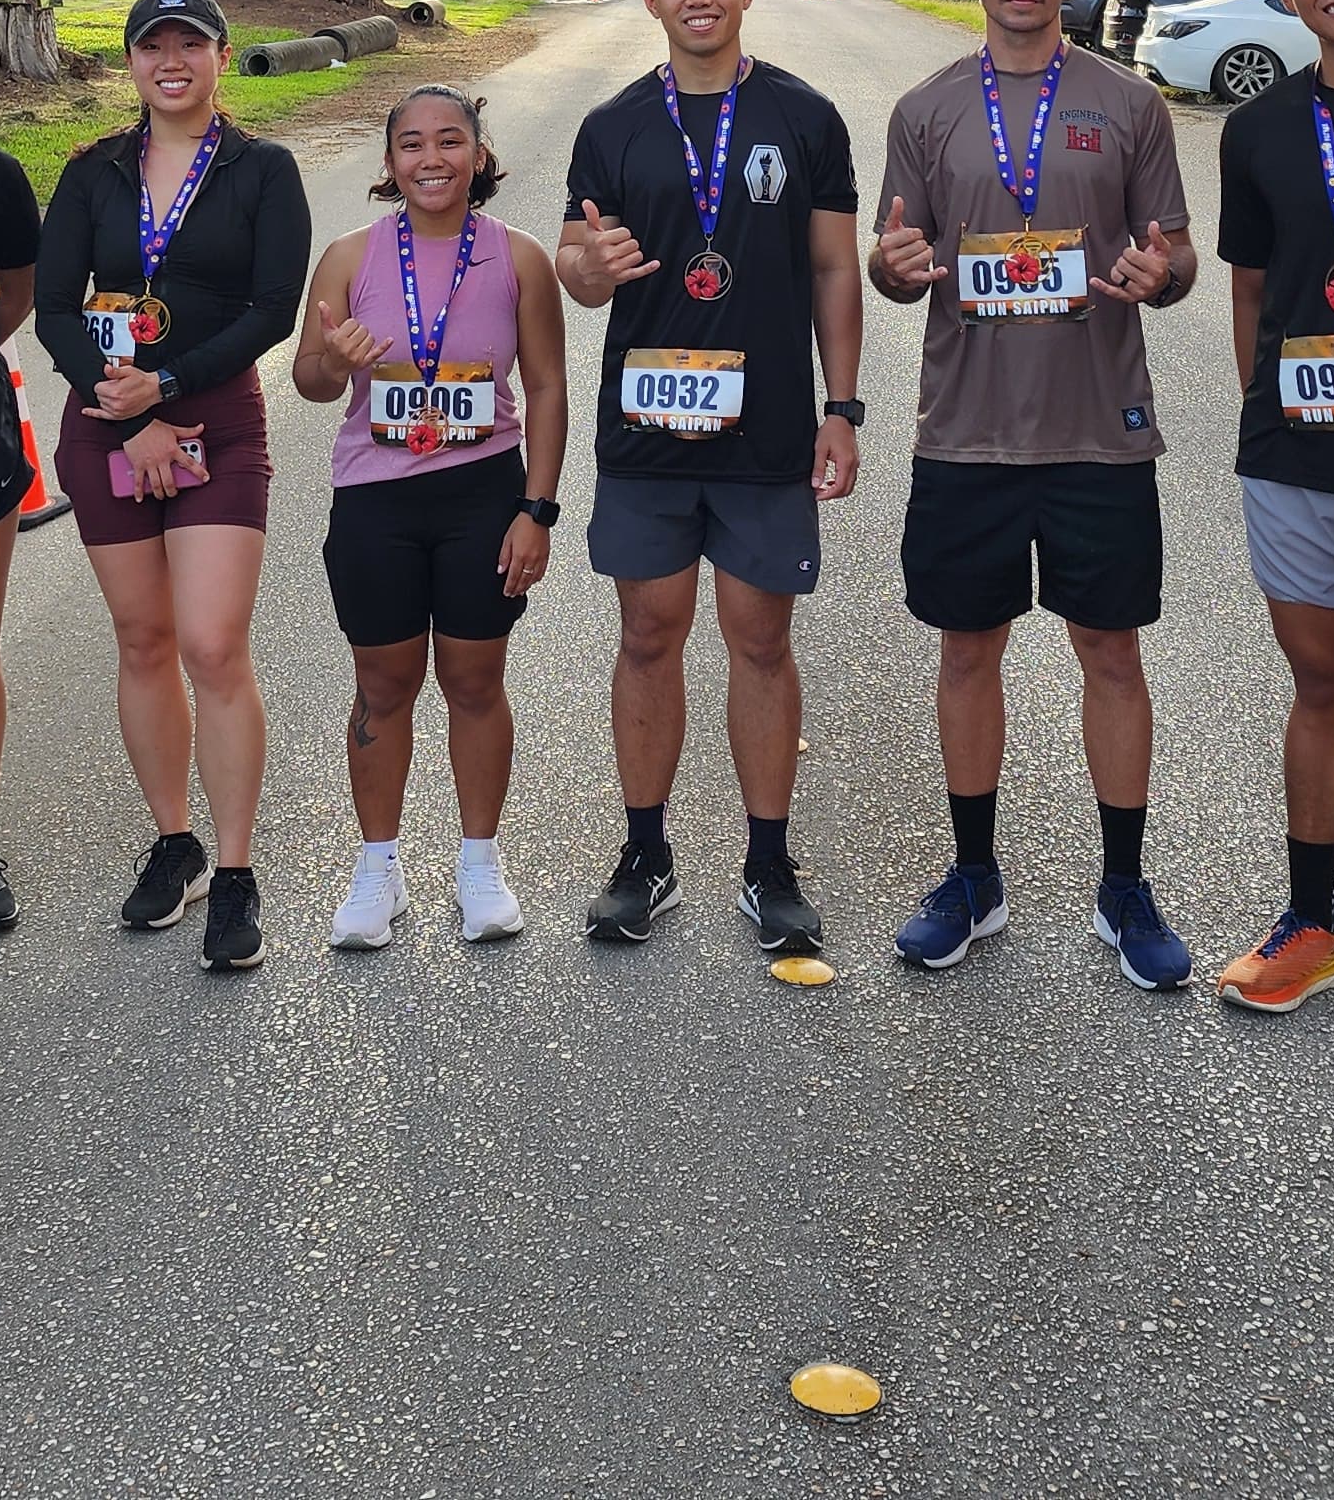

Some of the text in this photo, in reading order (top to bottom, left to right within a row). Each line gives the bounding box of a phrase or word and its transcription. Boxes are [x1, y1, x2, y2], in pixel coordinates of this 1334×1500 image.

[1059, 109, 1108, 126] ENGINEERS
[977, 299, 1069, 317] RUN SAIPAN
[637, 373, 720, 410] 0932
[386, 387, 473, 421] 0906
[1301, 407, 1334, 423] RUN
[669, 416, 722, 432] SAIPAN
[387, 427, 416, 440] RU
